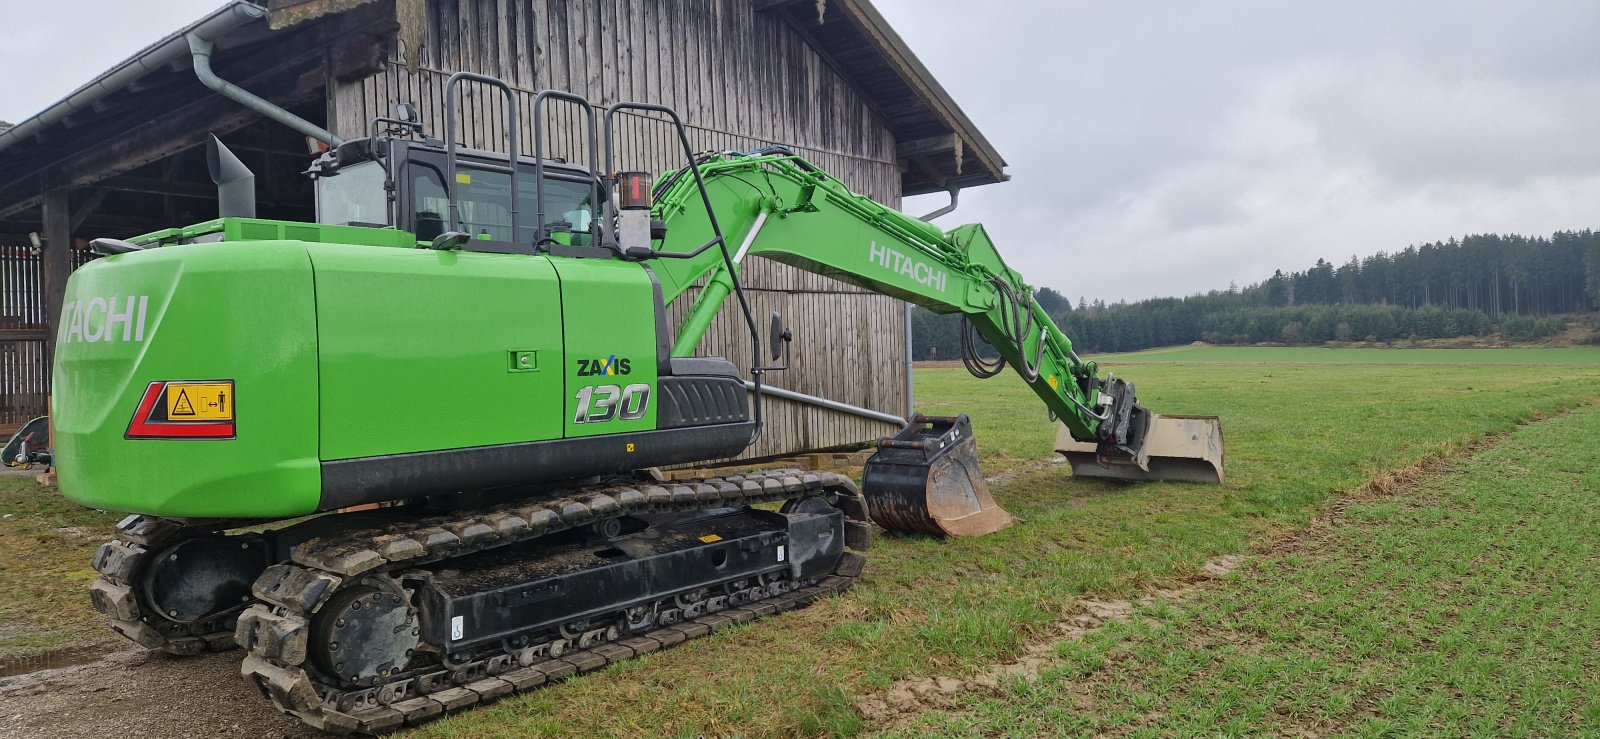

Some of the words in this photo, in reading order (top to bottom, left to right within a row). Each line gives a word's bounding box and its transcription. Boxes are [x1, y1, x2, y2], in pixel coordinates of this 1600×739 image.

[869, 240, 948, 293] HITACHI
[577, 354, 632, 377] ZAXIS
[574, 383, 651, 424] 130
